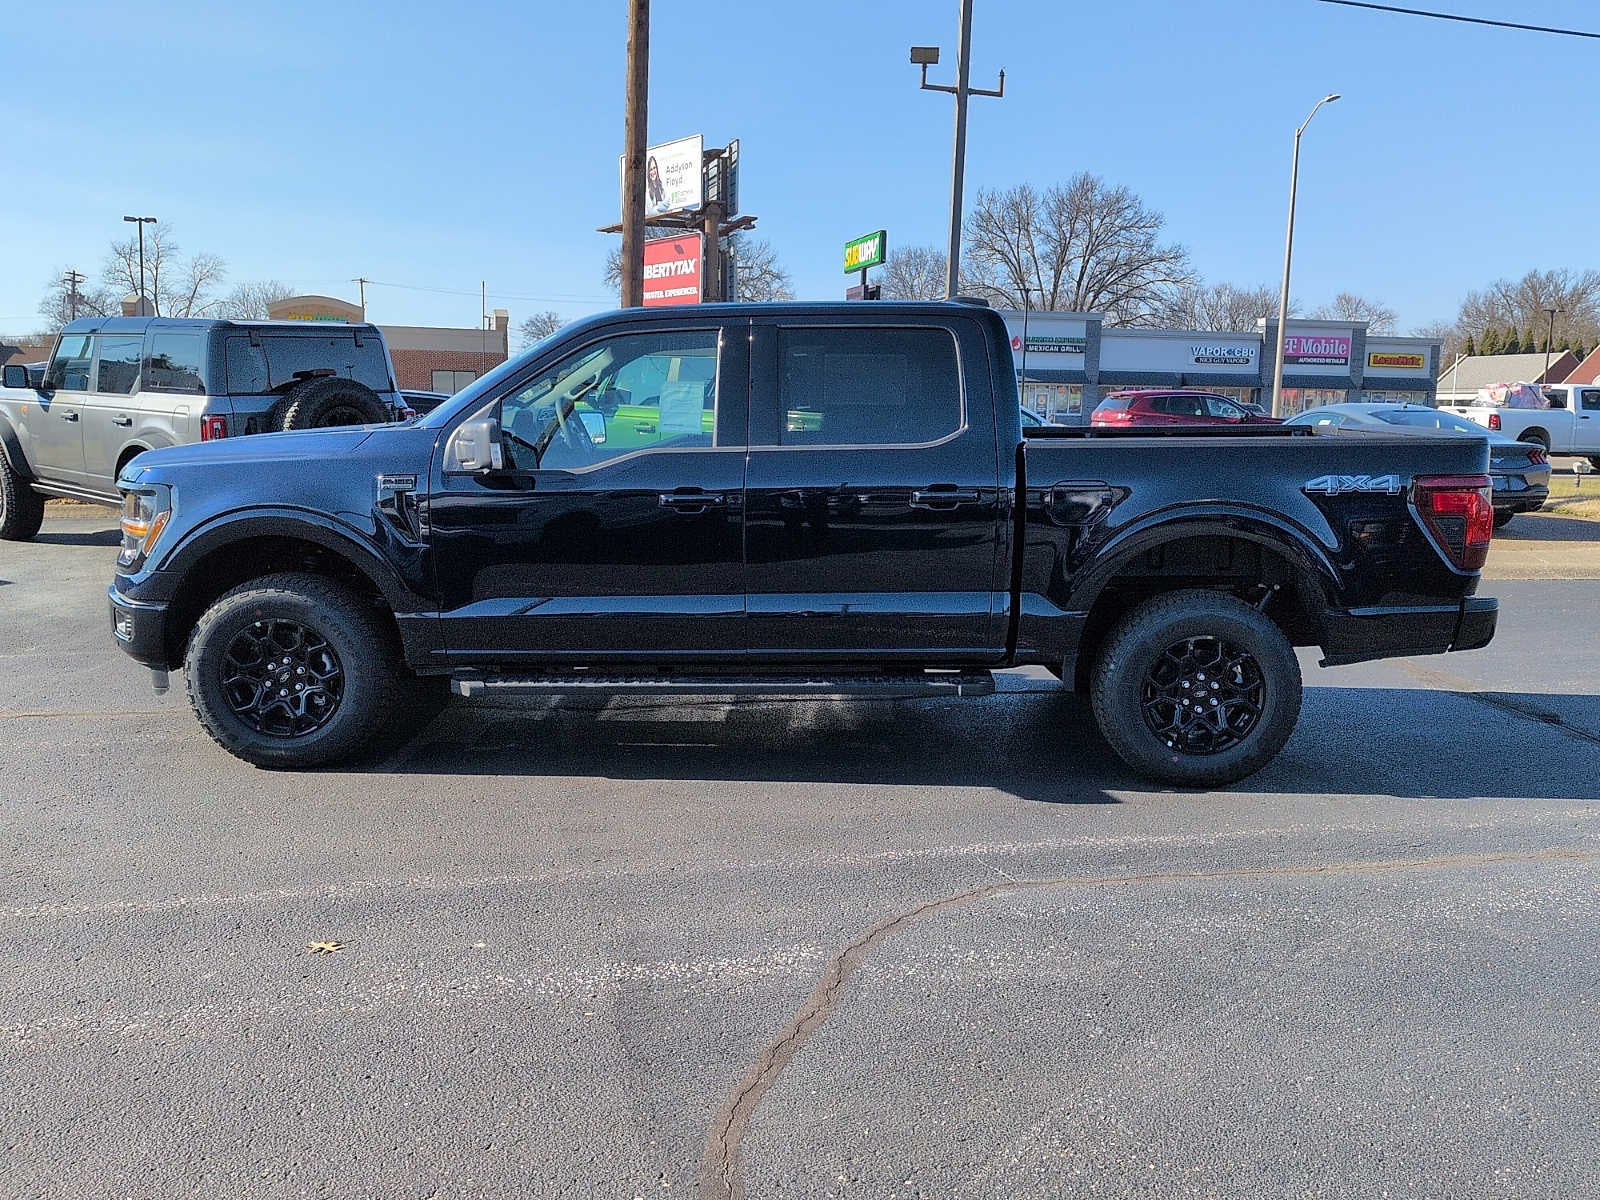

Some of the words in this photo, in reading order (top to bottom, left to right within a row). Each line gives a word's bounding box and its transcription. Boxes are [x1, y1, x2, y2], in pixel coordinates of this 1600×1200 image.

[666, 175, 683, 187] Floyd
[845, 236, 880, 268] SUBWAY
[1191, 346, 1228, 357] VAPOR
[1234, 347, 1256, 357] CBD
